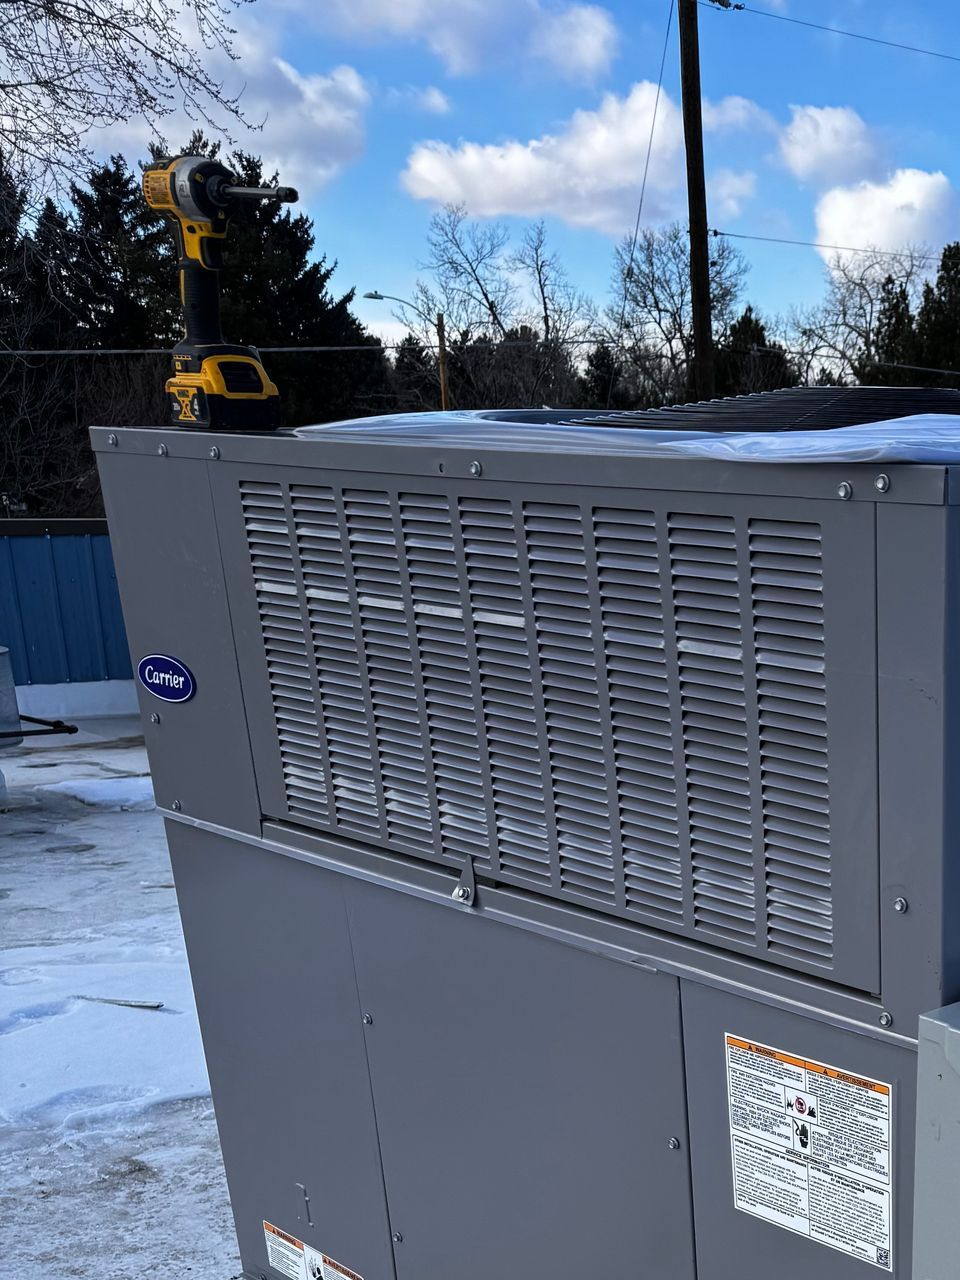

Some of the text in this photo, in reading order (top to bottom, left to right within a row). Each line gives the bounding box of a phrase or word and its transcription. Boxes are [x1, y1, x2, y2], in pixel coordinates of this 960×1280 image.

[145, 665, 185, 689] Carrier
[755, 1047, 776, 1058] WARNING
[837, 1073, 875, 1090] AVERTISSEMENT
[771, 1111, 786, 1120] HAZARD
[828, 1131, 842, 1140] RISQUE
[834, 1138, 846, 1146] RISQUE
[786, 1149, 830, 1168] SERVICE INFORMATION
[813, 1146, 826, 1155] TOUTES
[835, 1154, 862, 1168] ALIMENTATIONS
[853, 1150, 867, 1159] CAUSER
